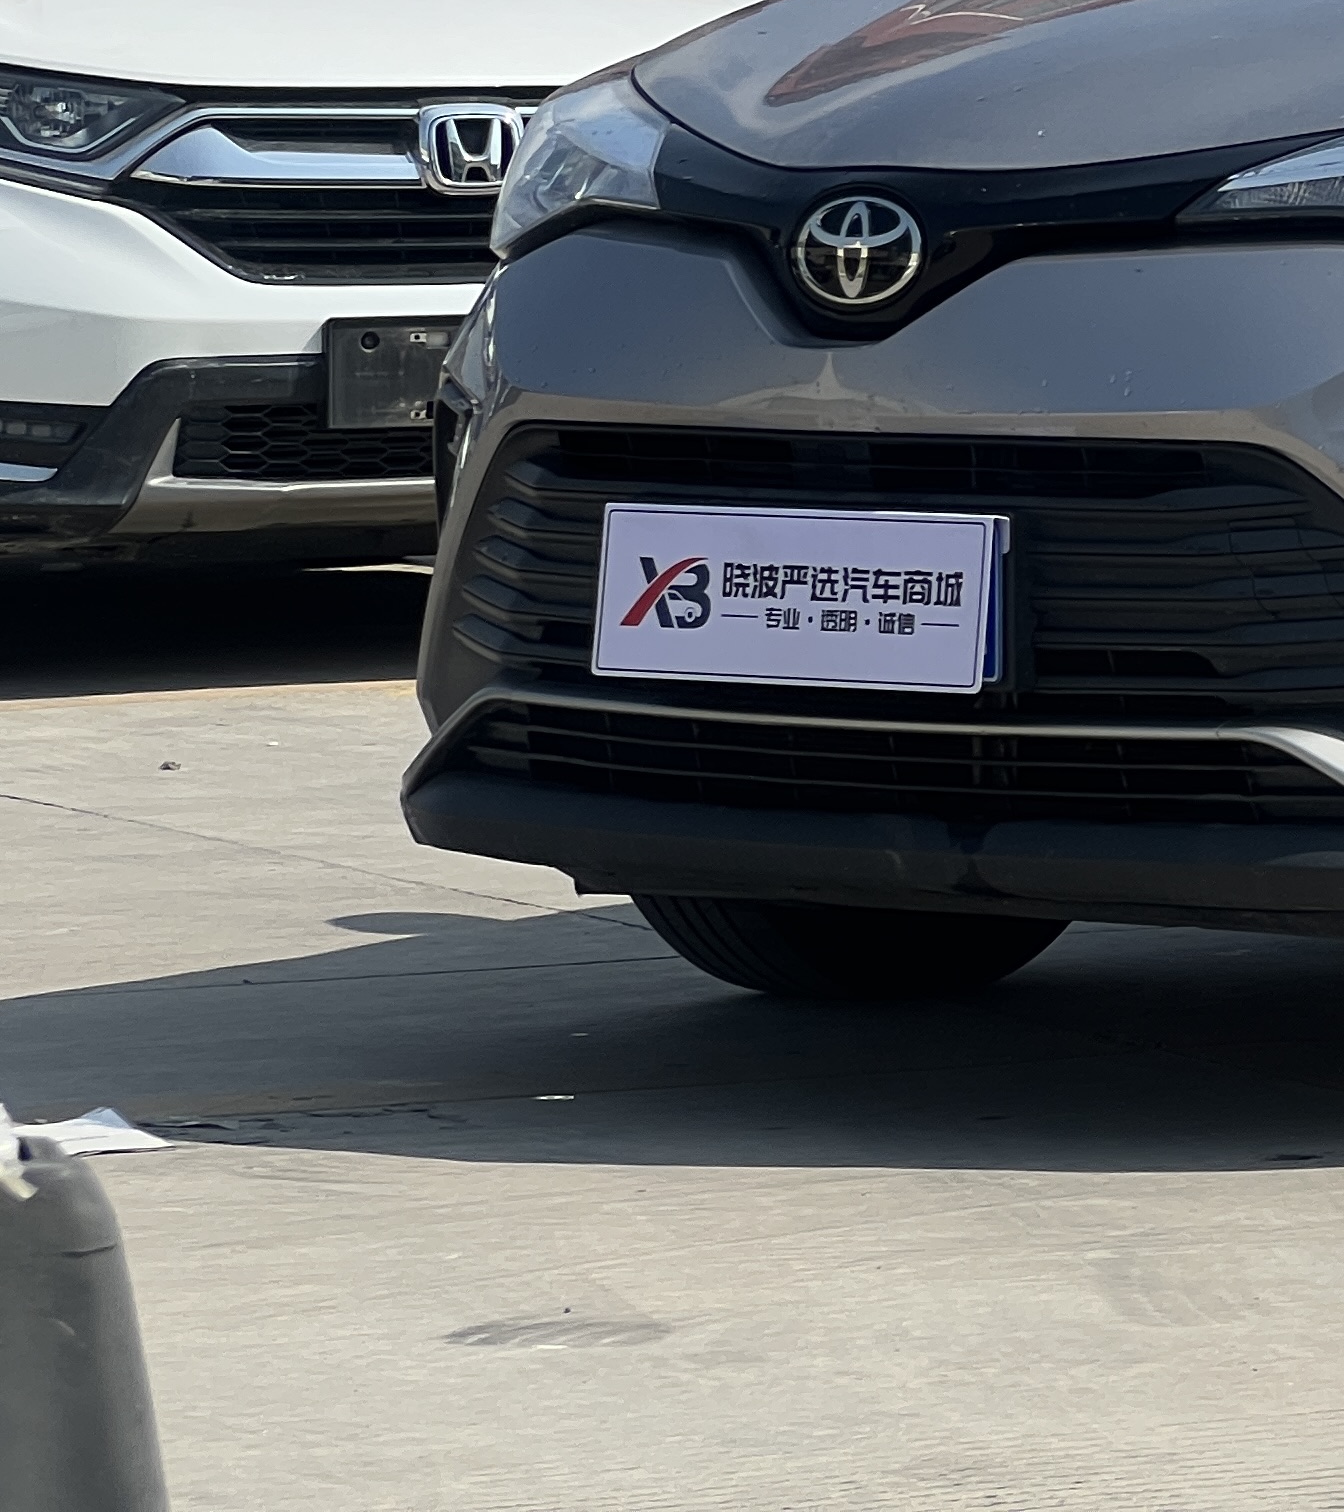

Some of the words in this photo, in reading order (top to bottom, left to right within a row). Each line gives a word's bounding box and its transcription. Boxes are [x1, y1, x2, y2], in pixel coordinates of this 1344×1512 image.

[722, 562, 964, 607] 晓波严选汽车商城
